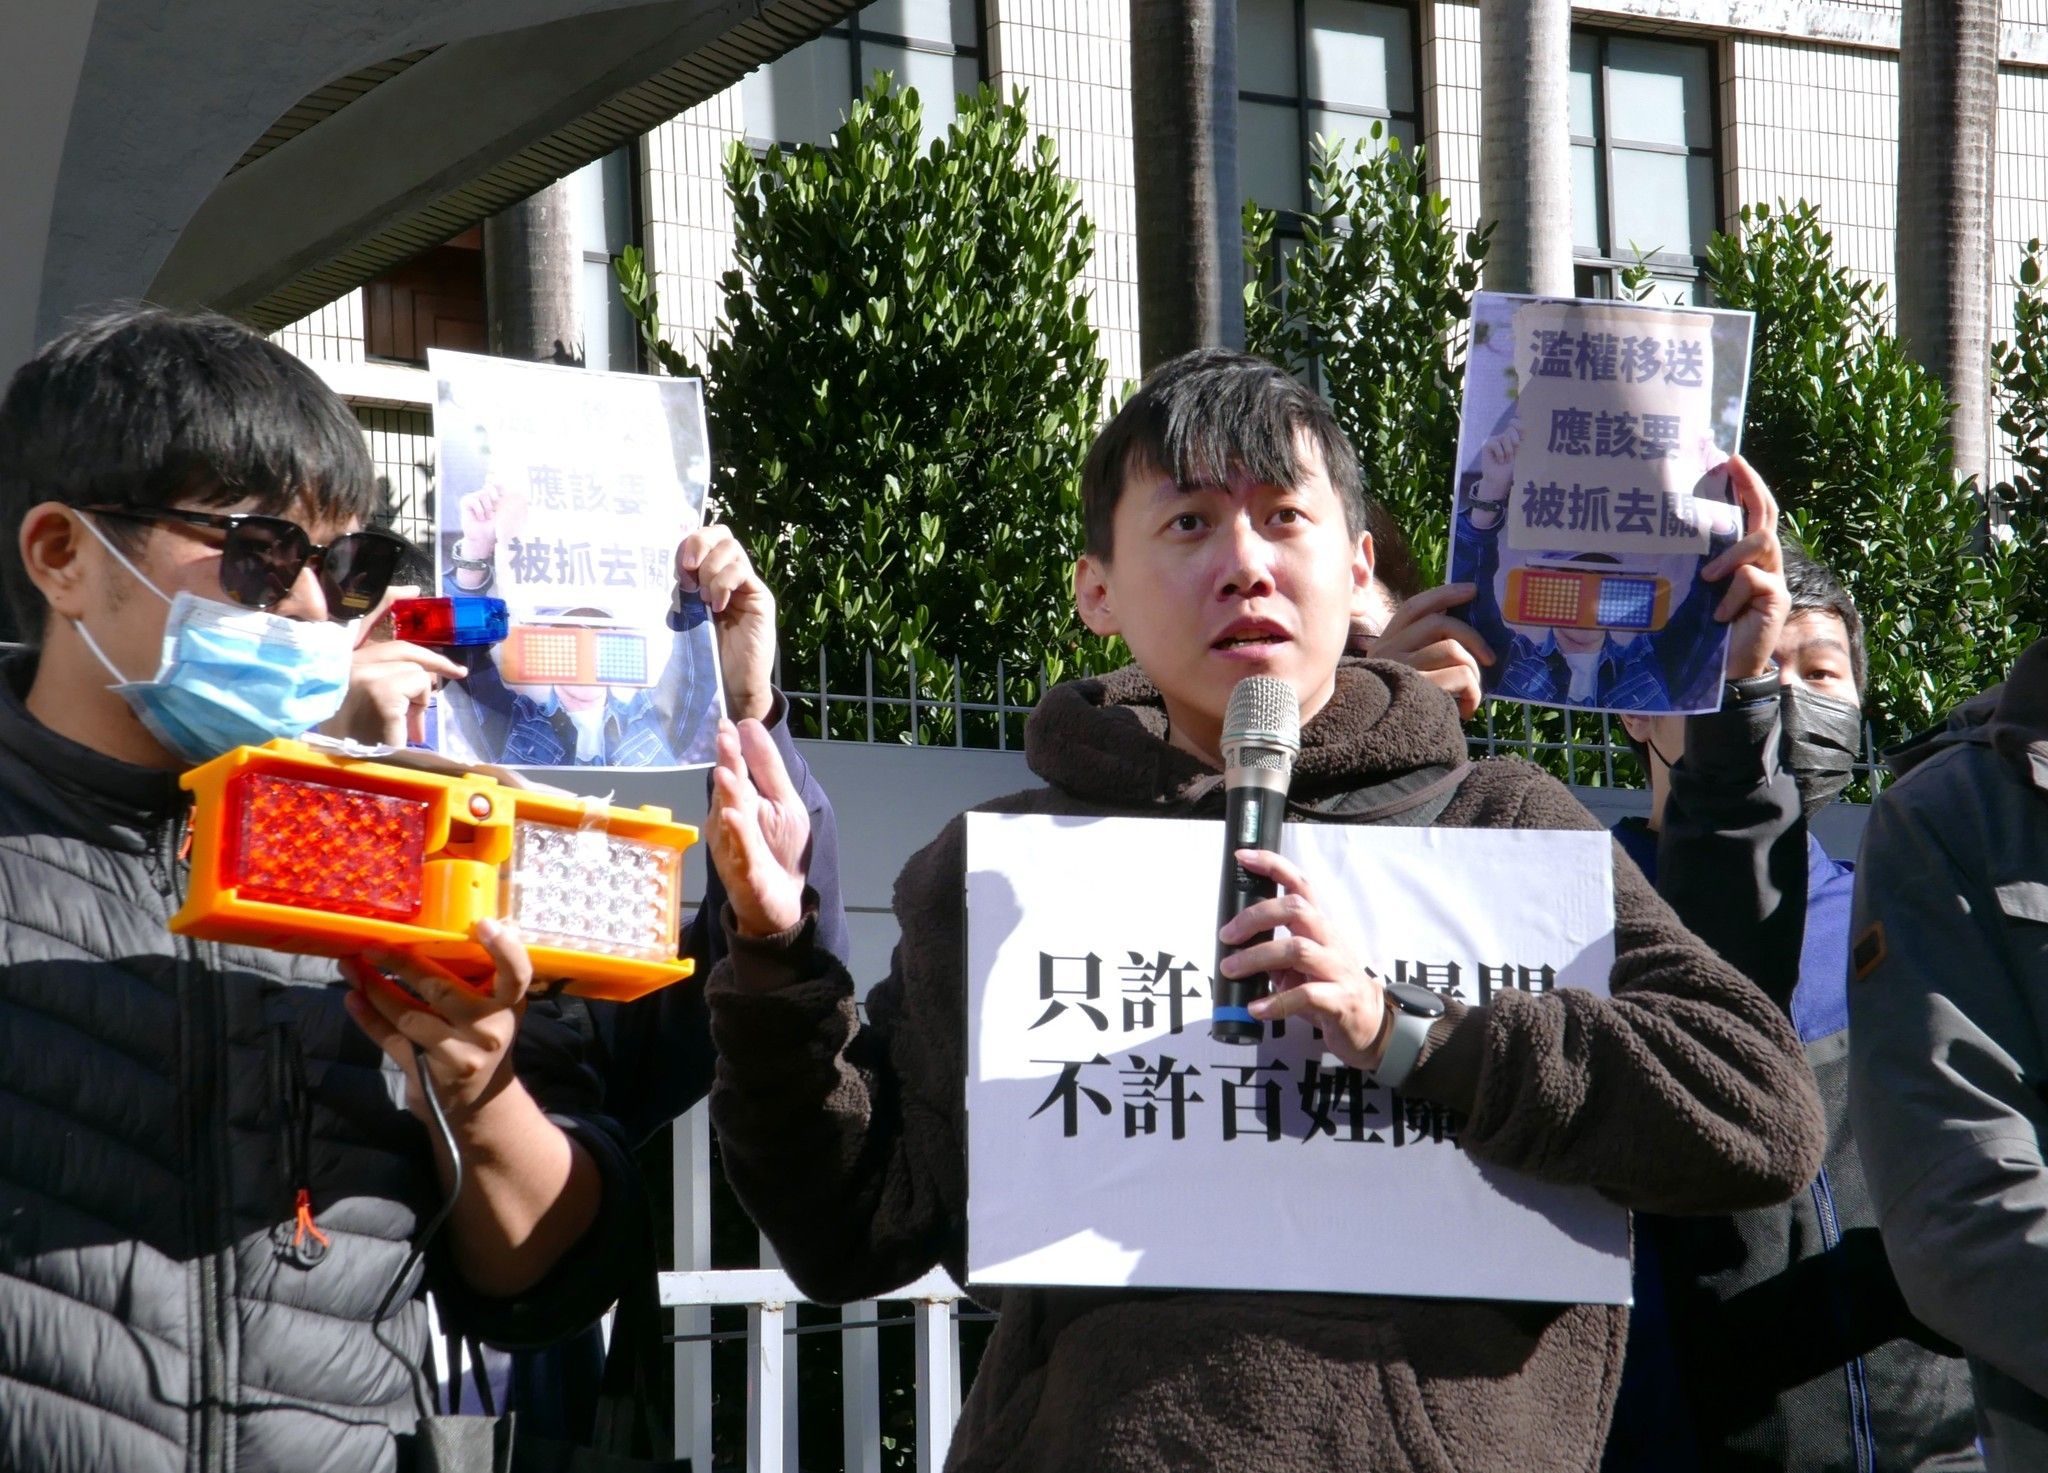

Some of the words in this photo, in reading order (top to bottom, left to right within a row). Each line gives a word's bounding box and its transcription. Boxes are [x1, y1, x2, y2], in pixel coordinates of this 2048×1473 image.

[1530, 329, 1703, 387] 濫權移送
[1548, 407, 1681, 460] 應該要
[1522, 481, 1699, 539] 被抓去關
